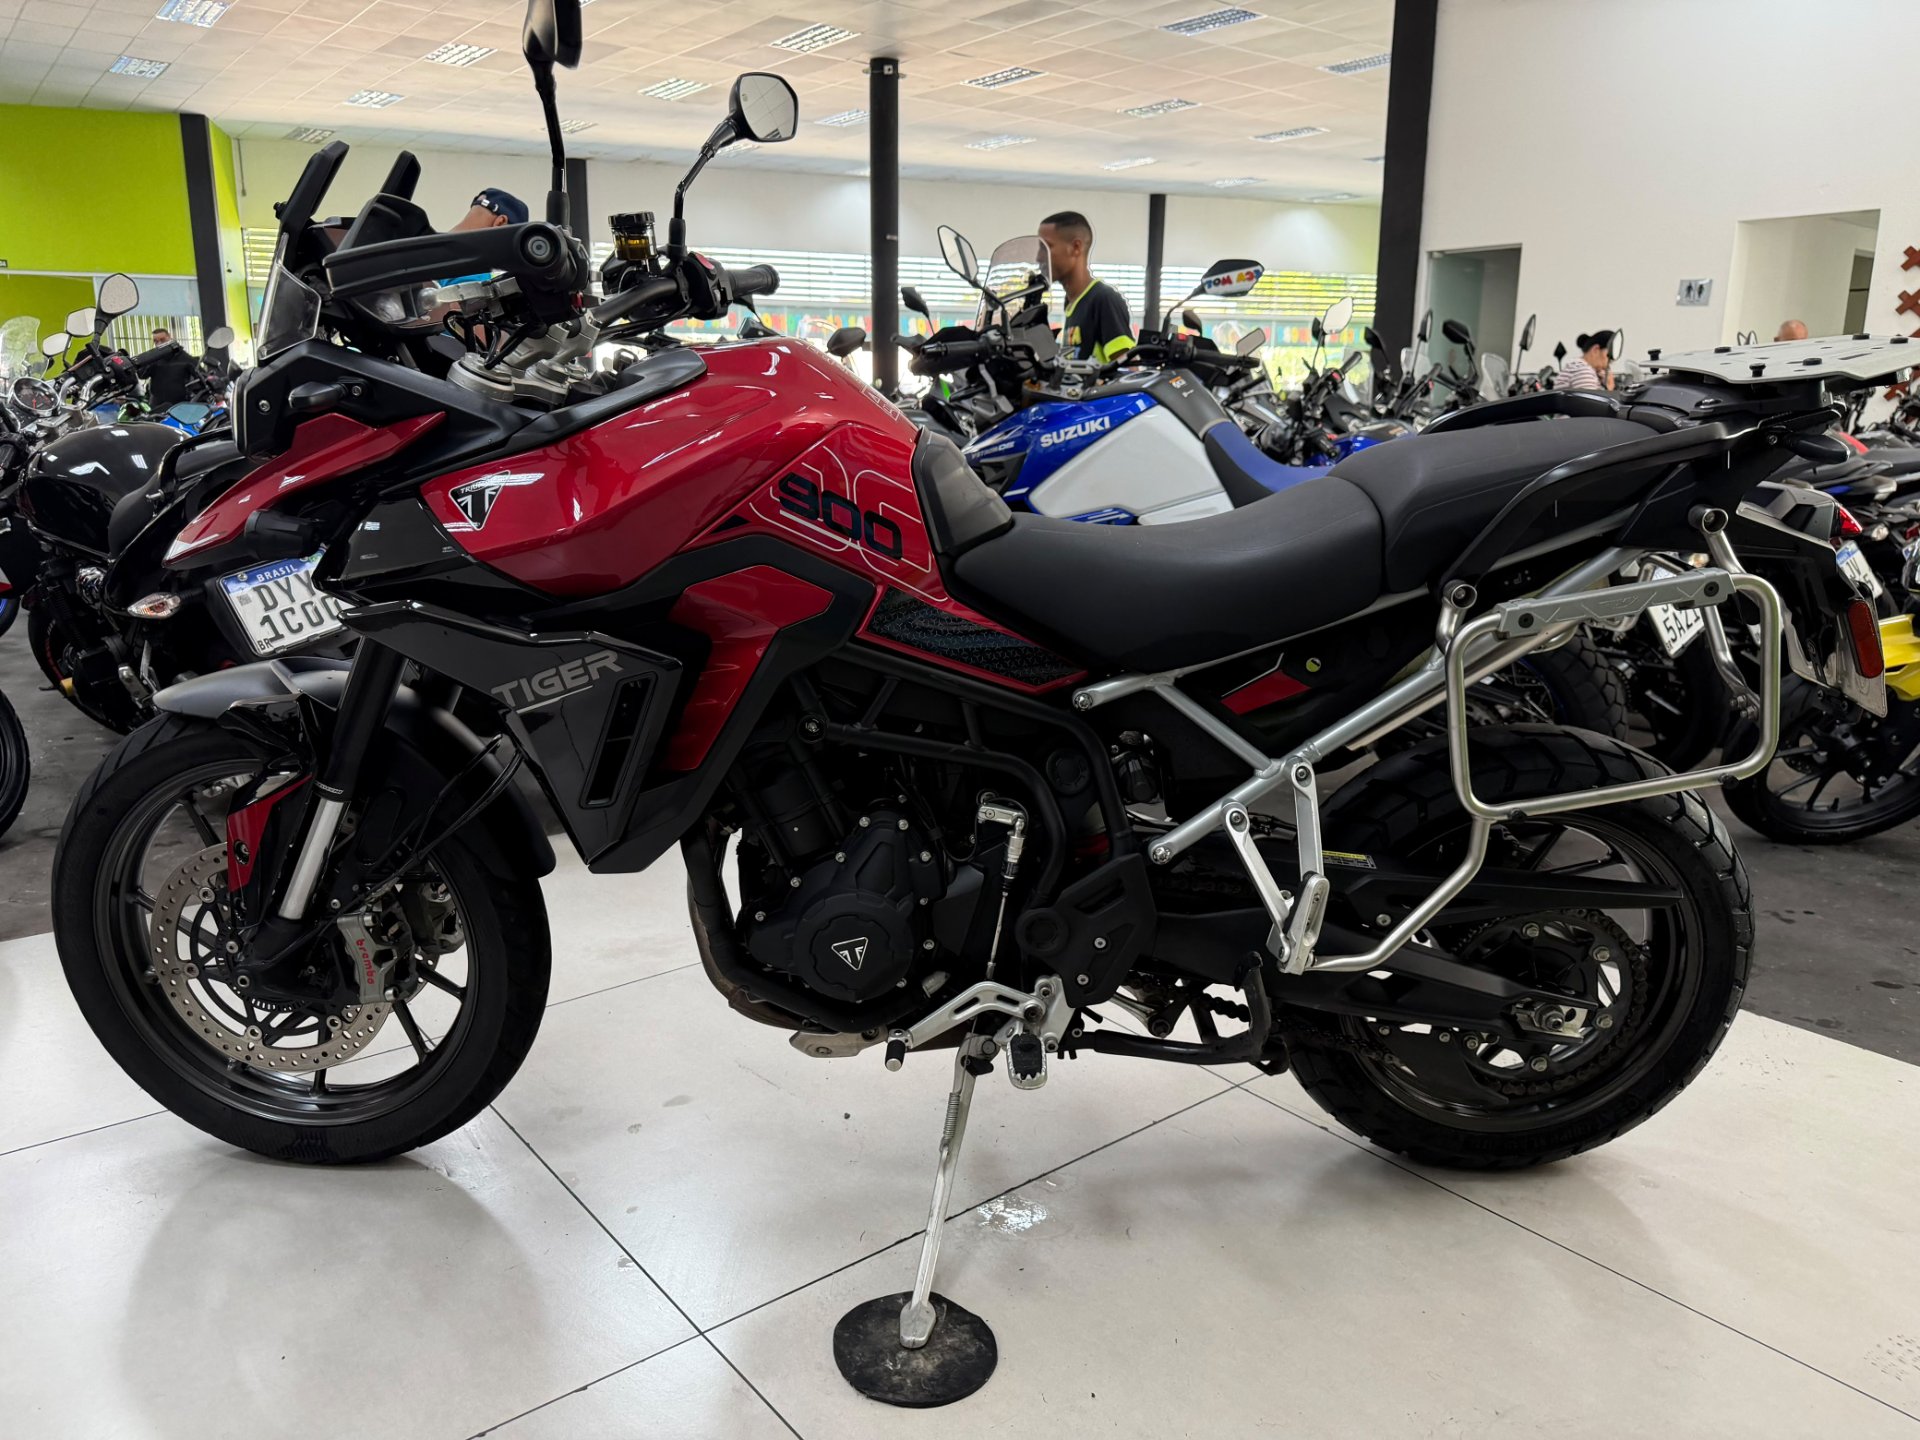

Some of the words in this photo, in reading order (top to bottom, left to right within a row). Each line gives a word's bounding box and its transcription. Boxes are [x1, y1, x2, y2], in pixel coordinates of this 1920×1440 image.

[1040, 416, 1111, 448] SUZUKI
[778, 472, 903, 560] 900
[253, 569, 316, 612] DYY
[256, 564, 298, 582] BRASIL
[257, 639, 273, 651] BR
[490, 649, 624, 707] TIGER
[356, 938, 376, 985] brembo
